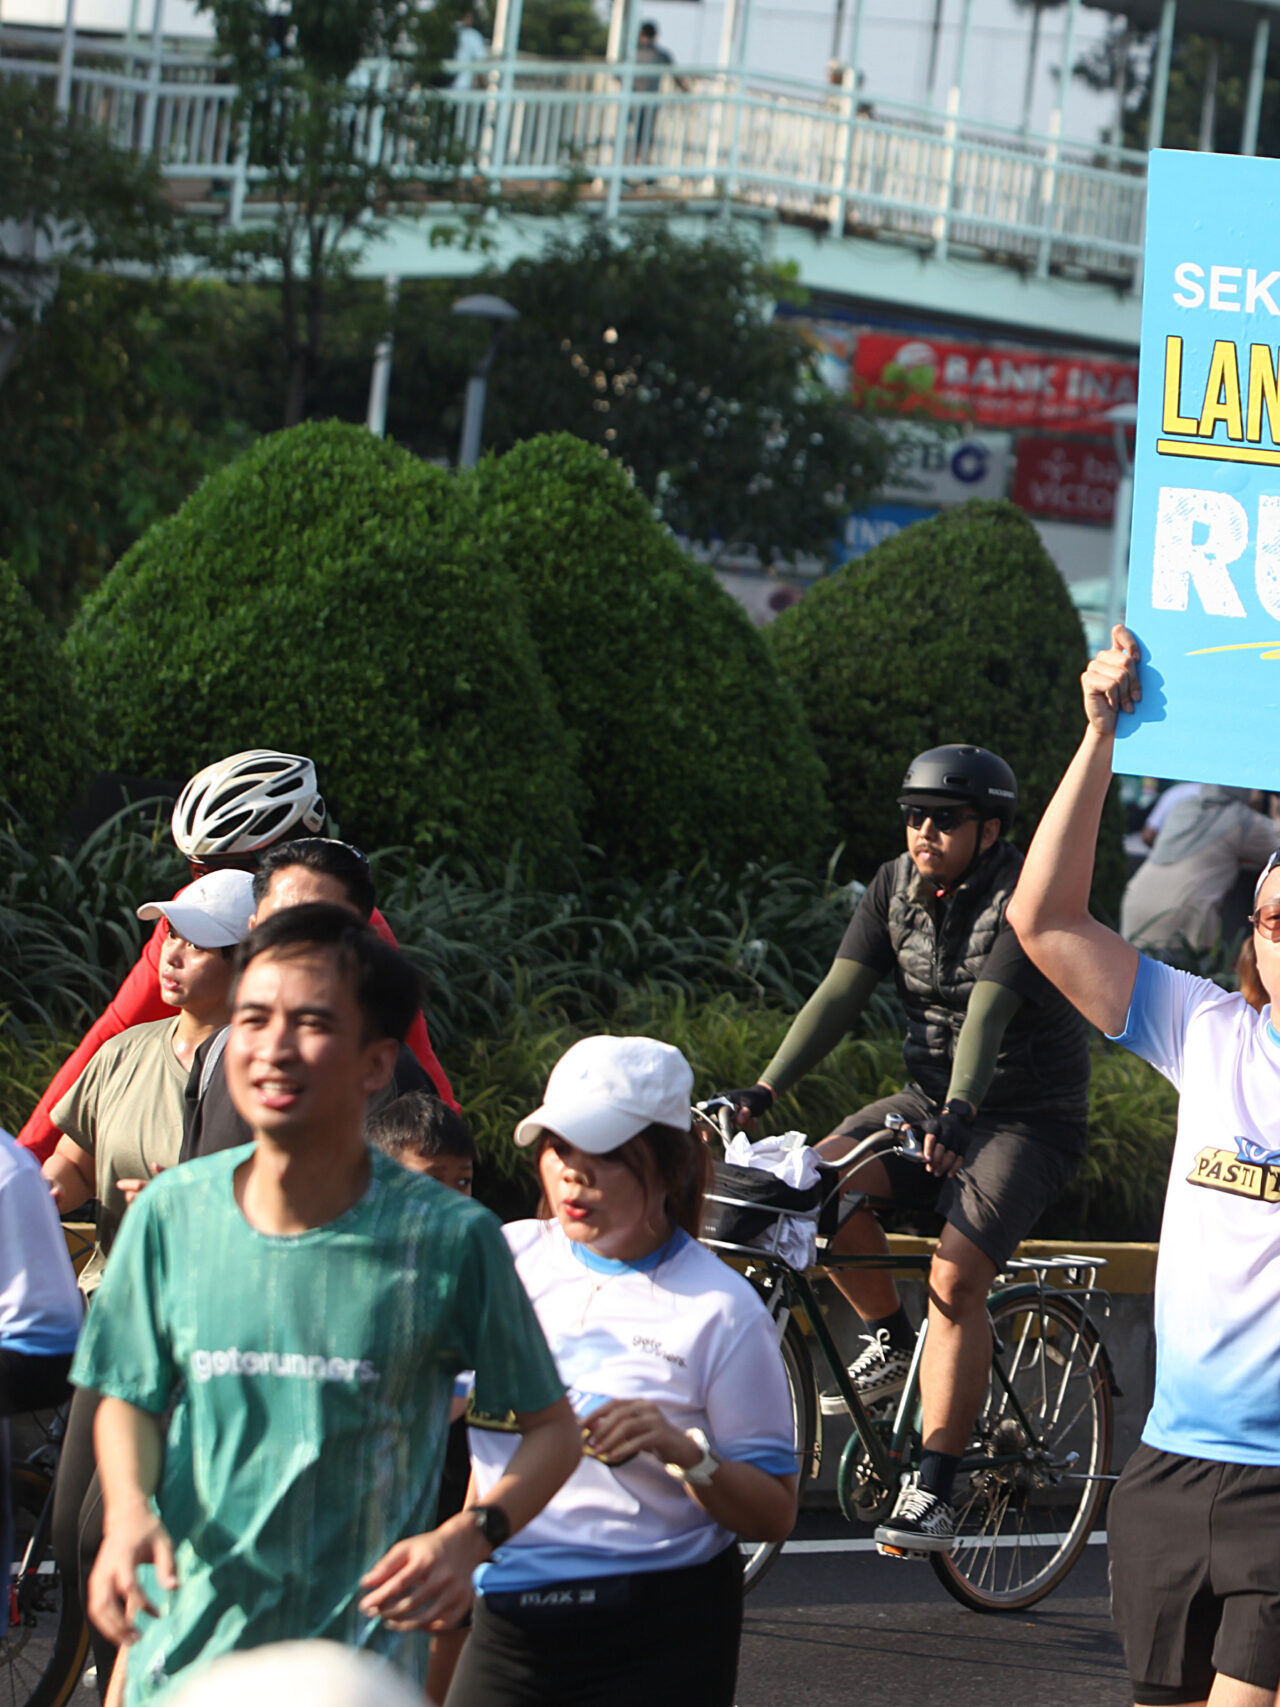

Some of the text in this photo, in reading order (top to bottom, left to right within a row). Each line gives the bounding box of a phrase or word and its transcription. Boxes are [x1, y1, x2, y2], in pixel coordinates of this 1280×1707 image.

[943, 354, 1058, 397] BANK
[1198, 1156, 1257, 1189] PASTI
[520, 1590, 574, 1607] MAX
